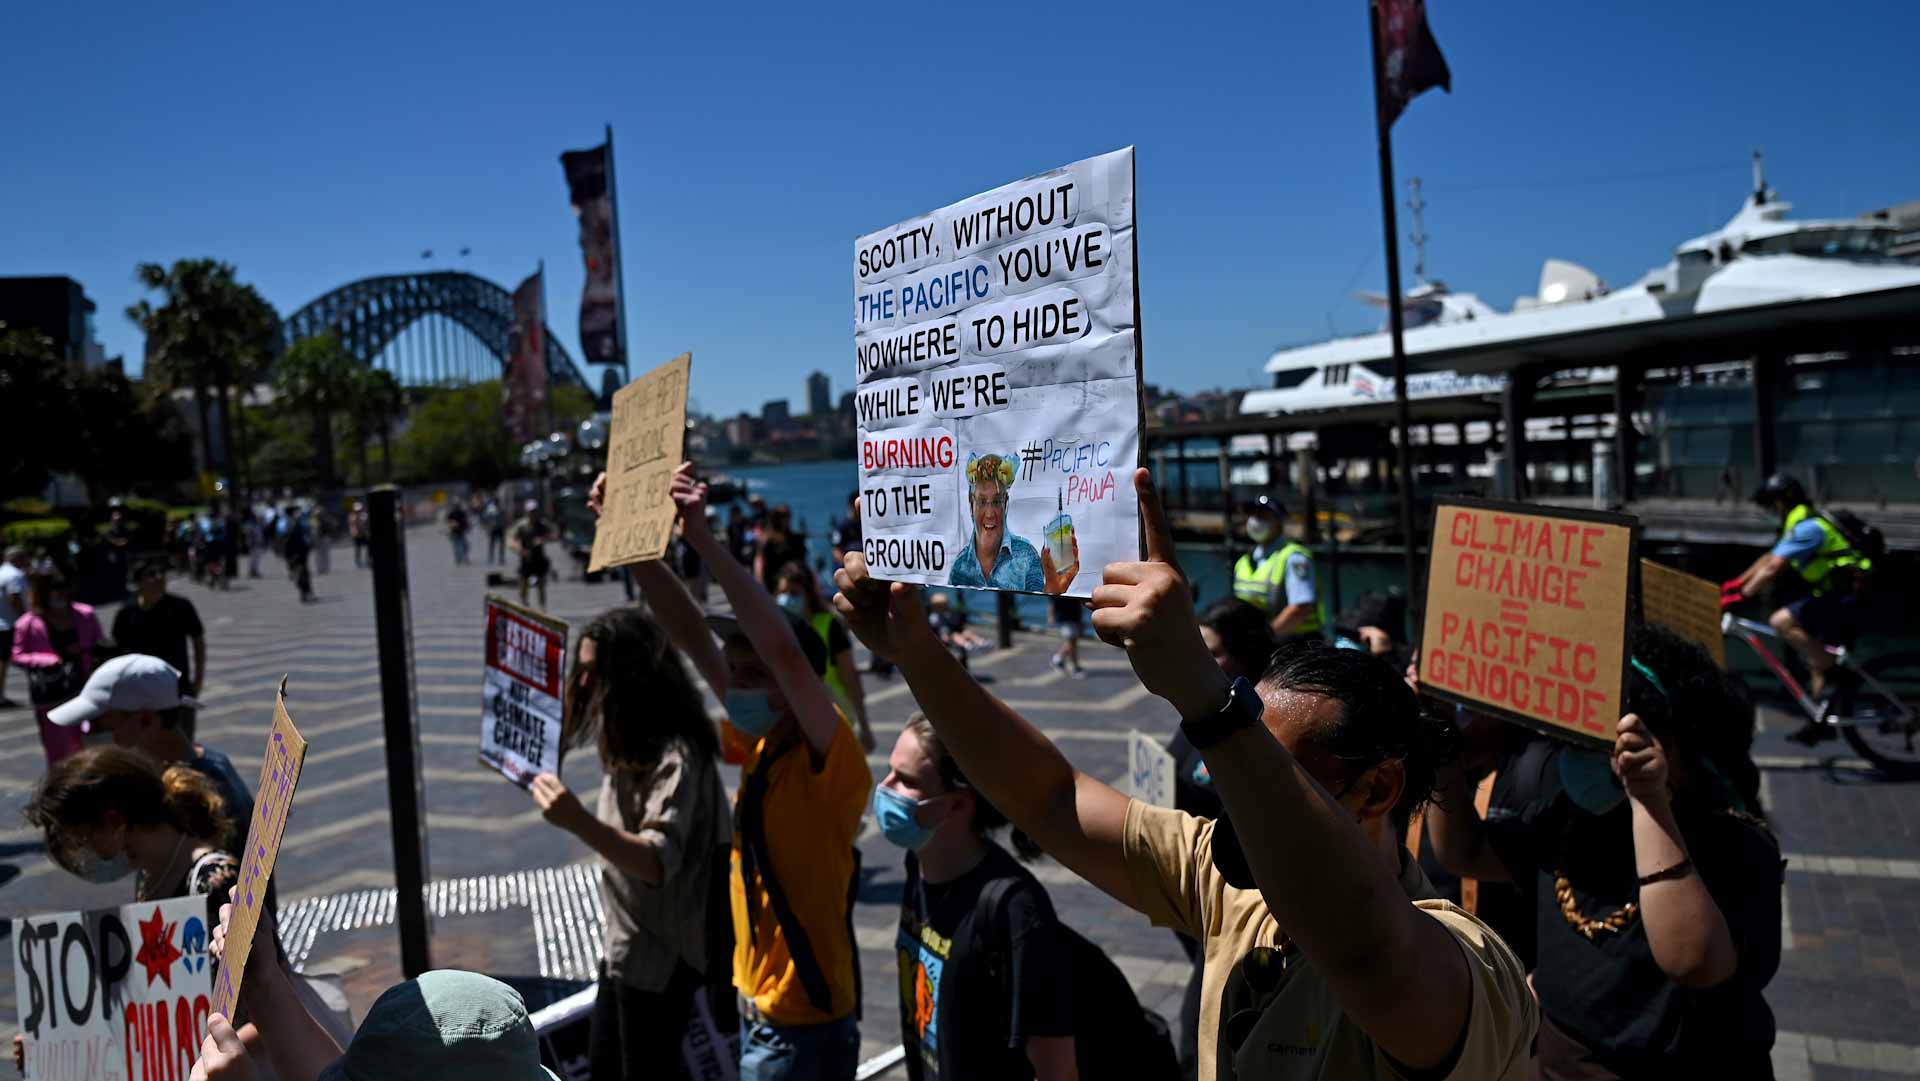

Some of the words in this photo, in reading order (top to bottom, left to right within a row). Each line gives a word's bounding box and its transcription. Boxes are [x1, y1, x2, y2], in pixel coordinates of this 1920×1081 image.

[859, 223, 940, 277] SCOTTY,
[954, 184, 1074, 250] WITHOUT
[859, 289, 894, 323] THE
[902, 265, 989, 317] PACIFIC
[999, 230, 1102, 285] YOU'VE
[858, 324, 957, 375] NOWHERE
[972, 315, 1004, 351] TO
[1013, 298, 1079, 345] HIDE
[859, 385, 919, 421] WHILE
[932, 372, 1008, 412] WE'RE
[864, 436, 953, 470] BURNING
[1021, 438, 1110, 482] #PACIFIC
[865, 488, 887, 517] TO
[892, 484, 931, 515] THE
[1067, 471, 1114, 506] PAWA
[865, 538, 945, 570] GROUND
[1451, 512, 1605, 568] CLIMATE
[1456, 552, 1587, 609] CHANGE
[1501, 600, 1529, 625] =
[1441, 612, 1597, 683] PACIFIC
[1428, 649, 1607, 733] GENOCIDE
[493, 694, 546, 742] CLIMATE
[493, 720, 543, 767] CHANGE
